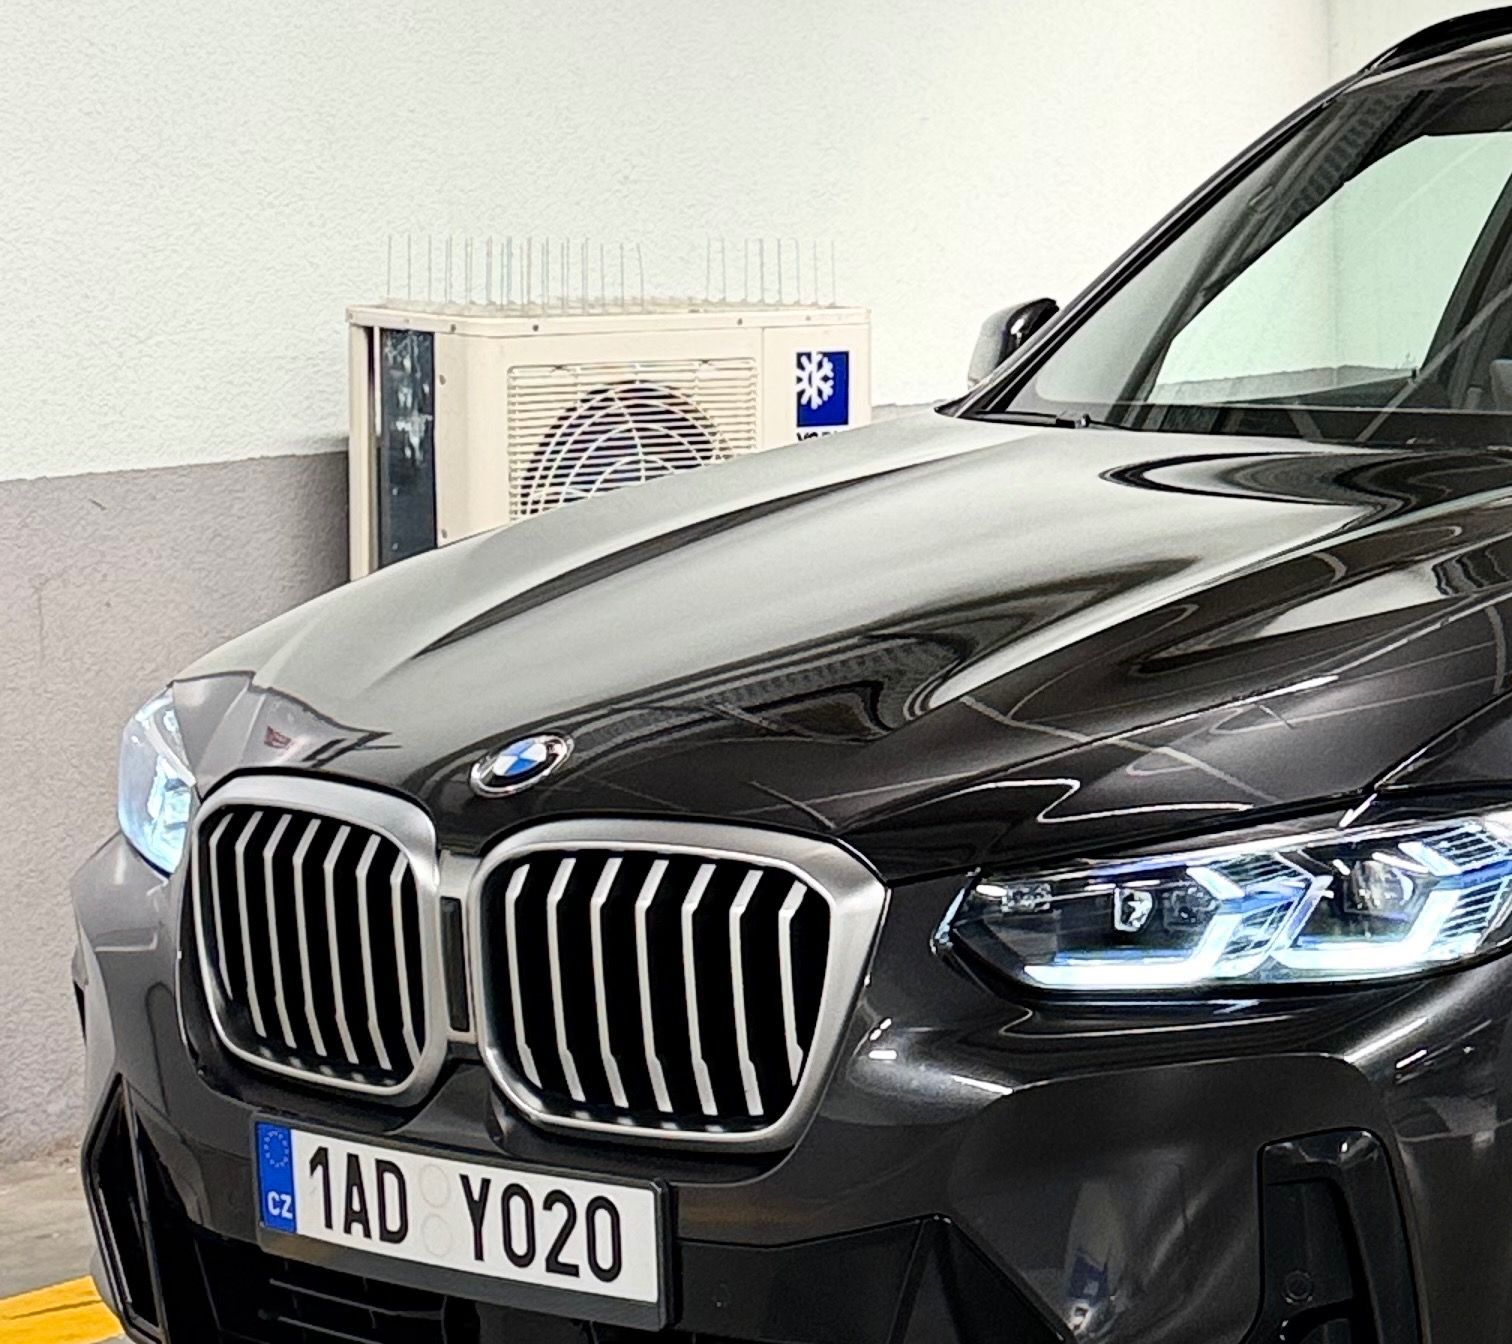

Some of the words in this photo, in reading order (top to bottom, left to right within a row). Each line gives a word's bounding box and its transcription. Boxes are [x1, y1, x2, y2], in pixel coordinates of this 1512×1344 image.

[267, 1190, 294, 1219] CZ
[309, 1146, 409, 1244] 1AD
[459, 1173, 623, 1283] Y020
